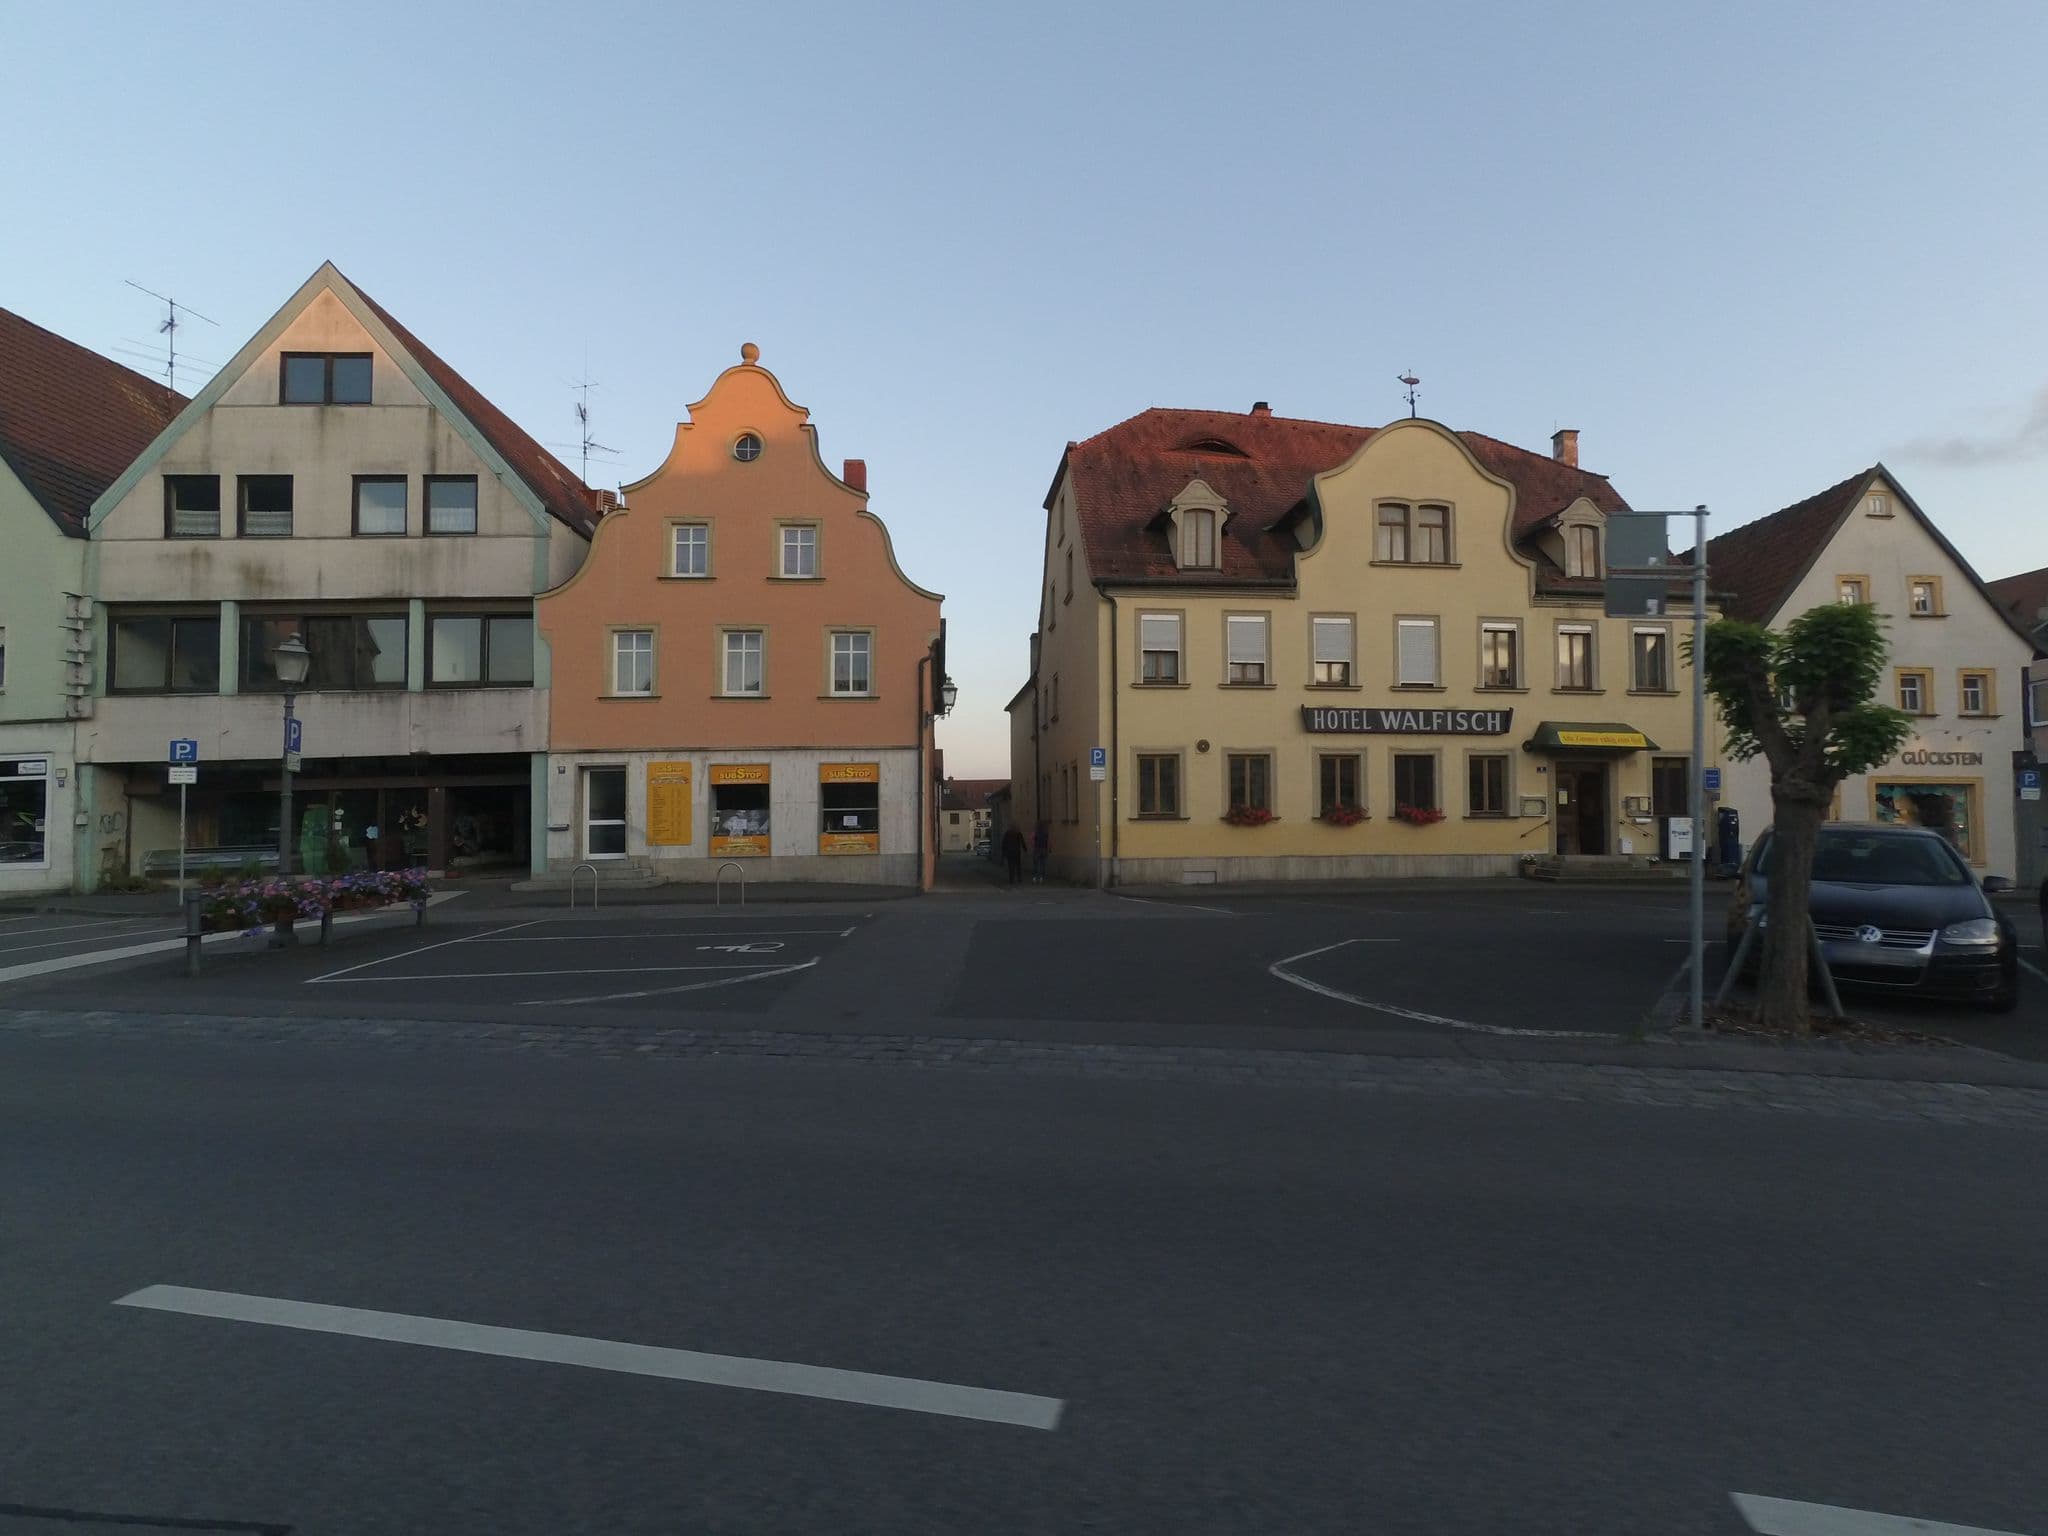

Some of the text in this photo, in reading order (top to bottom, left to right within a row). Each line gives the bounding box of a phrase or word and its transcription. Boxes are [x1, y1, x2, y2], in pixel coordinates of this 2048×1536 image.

[1313, 709, 1501, 732] HOTEL WALFISCH
[290, 722, 300, 747] P
[175, 742, 191, 760] P
[1093, 749, 1103, 764] P
[1901, 748, 1983, 766] GLÜCKSTEIN
